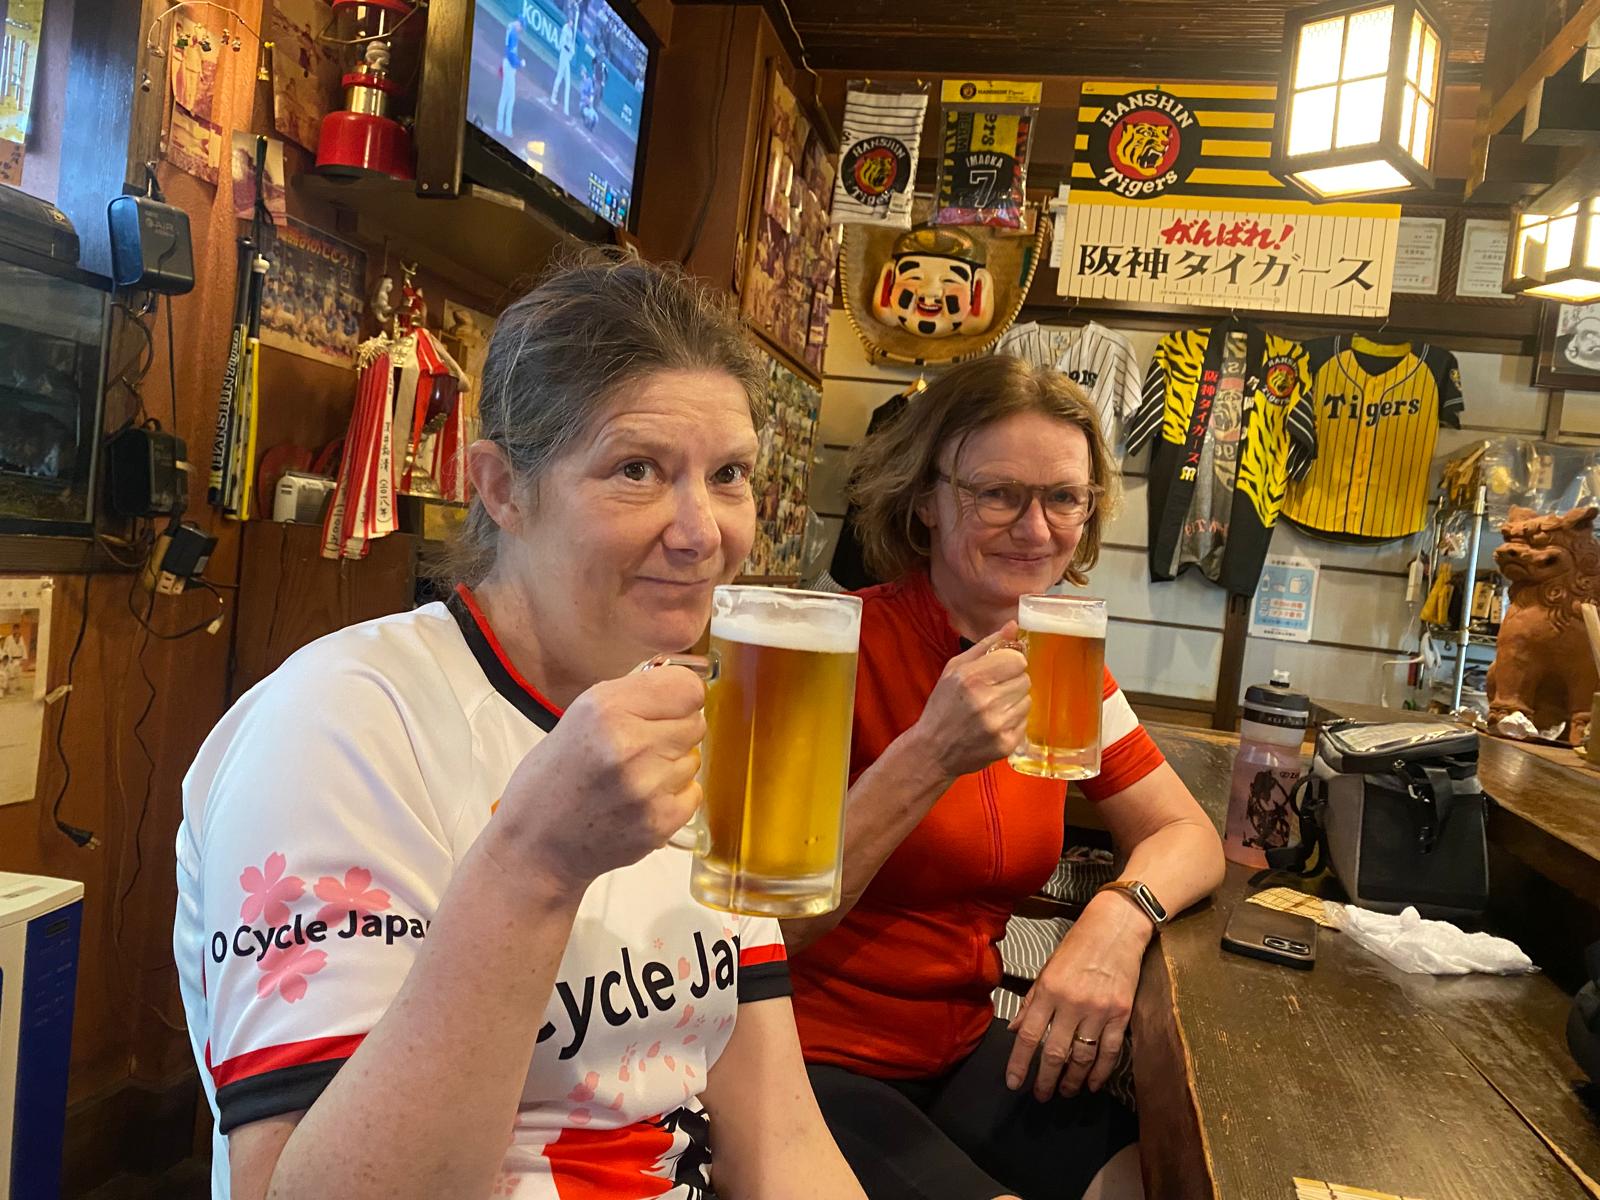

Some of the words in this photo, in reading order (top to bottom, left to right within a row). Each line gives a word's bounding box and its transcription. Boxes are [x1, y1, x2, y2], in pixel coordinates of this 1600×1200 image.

[1100, 93, 1194, 128] HANSHIN
[852, 138, 906, 158] HANSHIN
[969, 169, 997, 208] 7
[1099, 166, 1178, 197] Tigers
[1076, 243, 1377, 291] 阪神タイガース
[1323, 393, 1420, 427] Tigers
[232, 914, 328, 962] Cycle
[535, 947, 676, 1061] ycle
